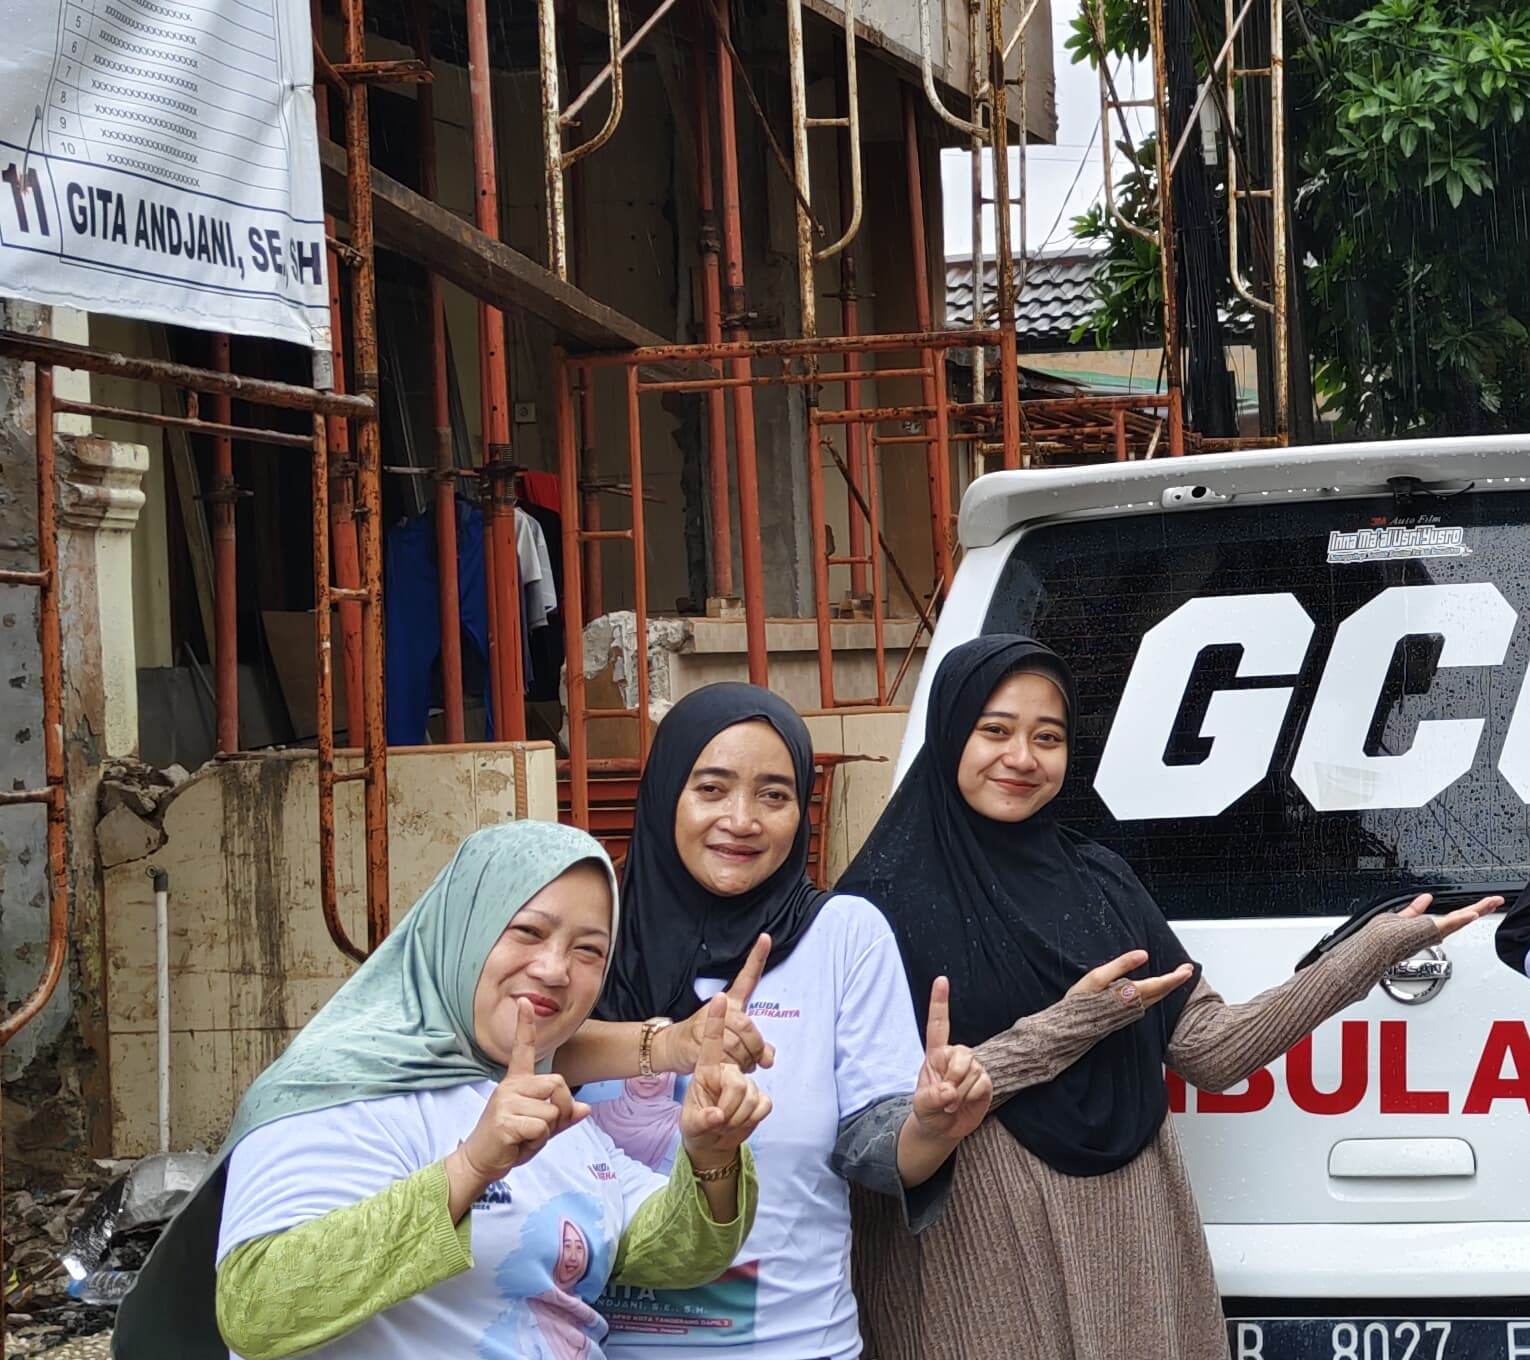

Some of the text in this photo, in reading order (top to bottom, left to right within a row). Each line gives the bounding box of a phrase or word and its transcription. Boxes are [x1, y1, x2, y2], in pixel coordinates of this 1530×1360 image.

[75, 16, 81, 29] 5
[71, 41, 78, 53] 6
[65, 65, 72, 77] 7
[60, 91, 66, 103] 8
[59, 116, 67, 129] 9
[61, 142, 76, 155] 10
[1, 162, 50, 237] 11
[66, 182, 128, 245] GITA
[135, 199, 245, 280] ANDJANI,
[1331, 533, 1357, 551] Inna
[749, 1001, 780, 1010] MUDA
[748, 1009, 800, 1018] BERKARYA
